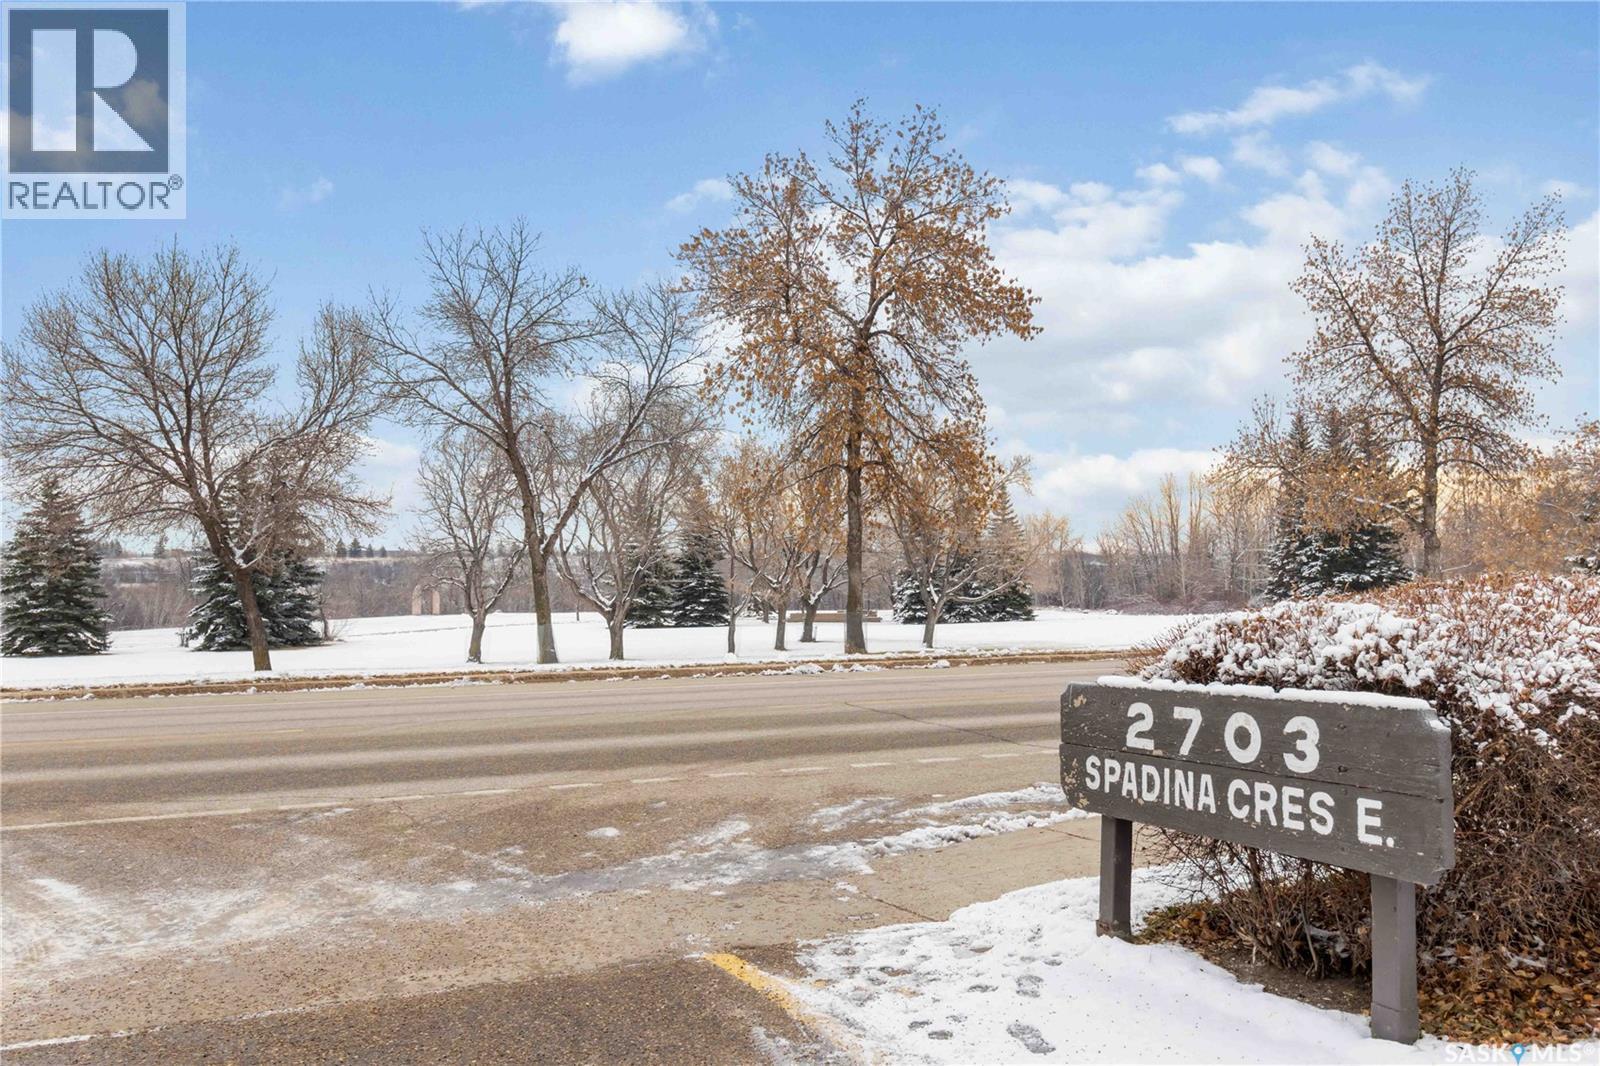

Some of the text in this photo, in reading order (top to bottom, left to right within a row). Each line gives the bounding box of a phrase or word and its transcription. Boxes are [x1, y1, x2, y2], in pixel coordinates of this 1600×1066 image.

[1125, 702, 1321, 773] 2703
[1085, 755, 1396, 847] SPADINA CRES E.
